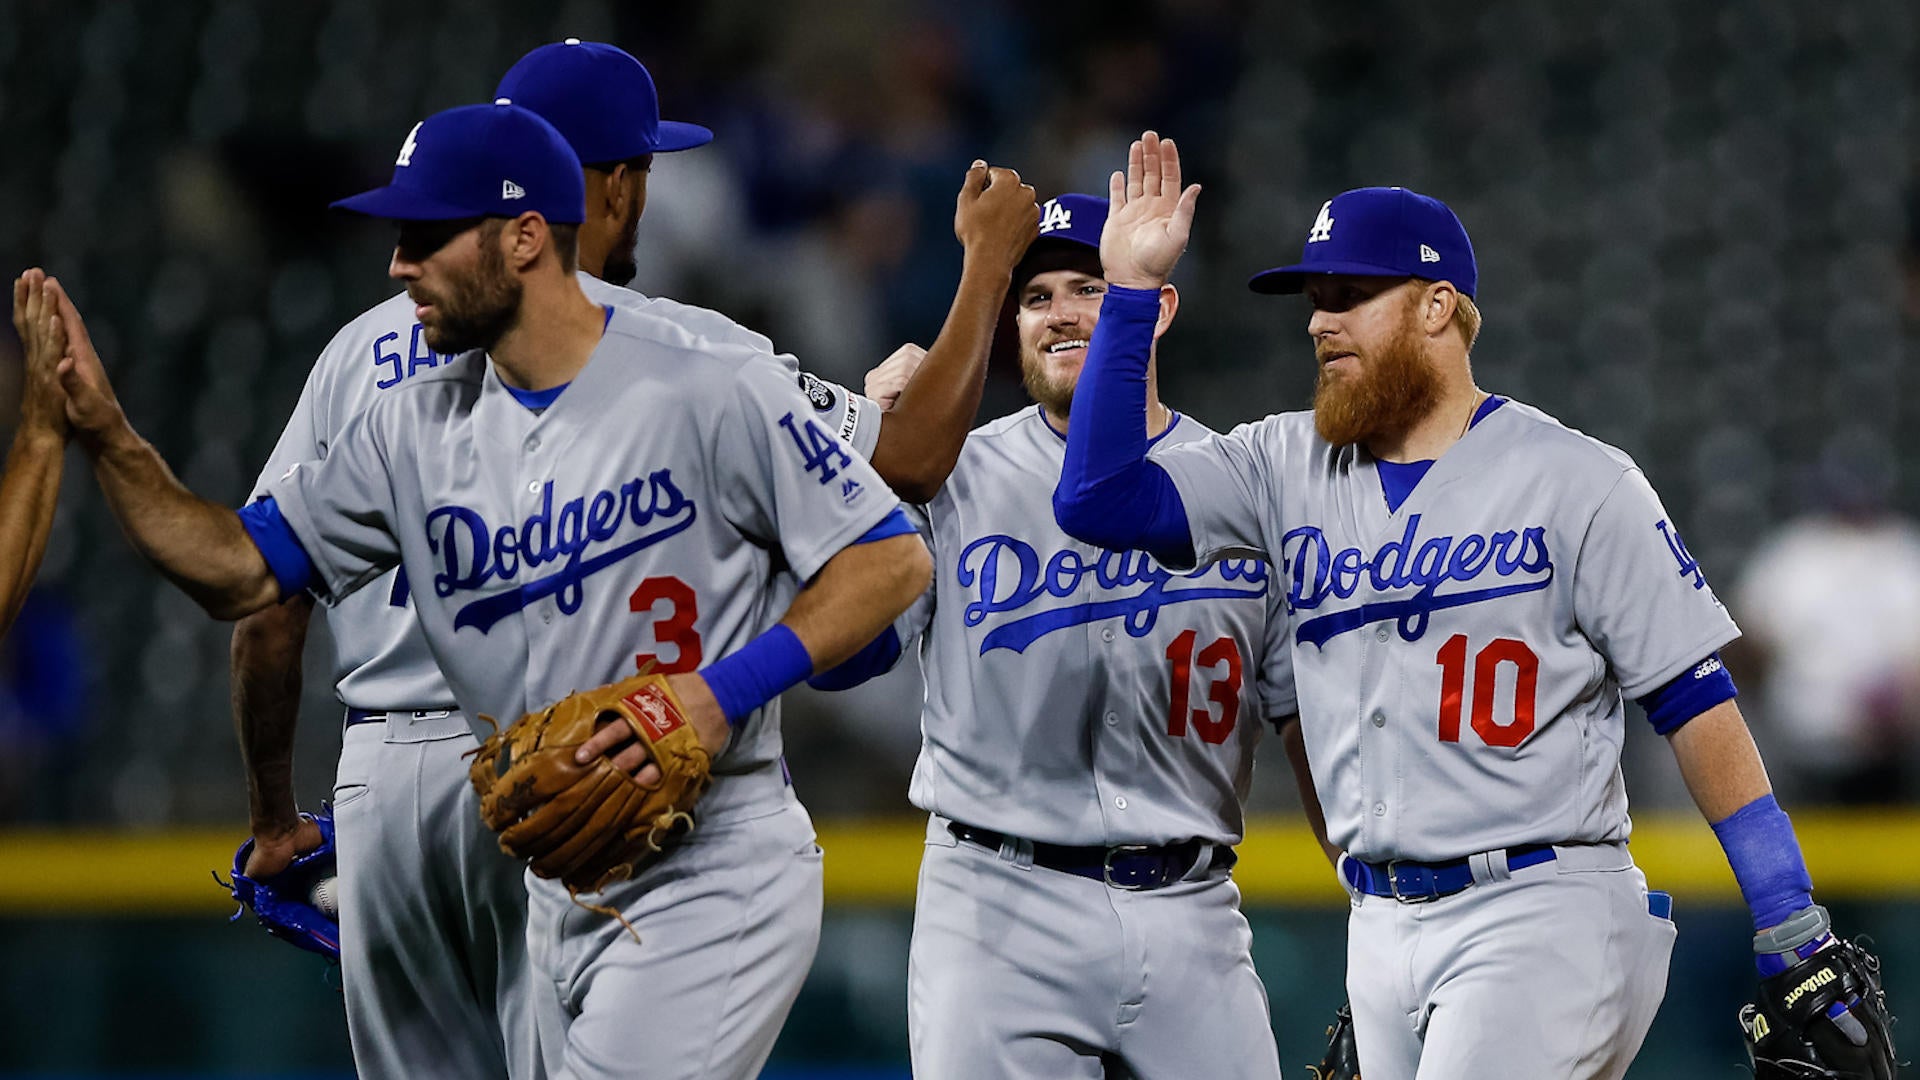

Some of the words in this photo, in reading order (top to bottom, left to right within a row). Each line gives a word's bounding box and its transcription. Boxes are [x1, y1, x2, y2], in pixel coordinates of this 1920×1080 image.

[1039, 198, 1072, 234] LA
[374, 322, 456, 390] SA
[778, 411, 852, 486] LA
[426, 468, 697, 618] Dodgers
[957, 534, 1268, 639] Dodg
[1282, 513, 1554, 642] Dodgers
[629, 576, 703, 676] 3
[1166, 629, 1243, 745] 13
[1436, 633, 1539, 747] 10
[1784, 966, 1838, 1007] Wilson
